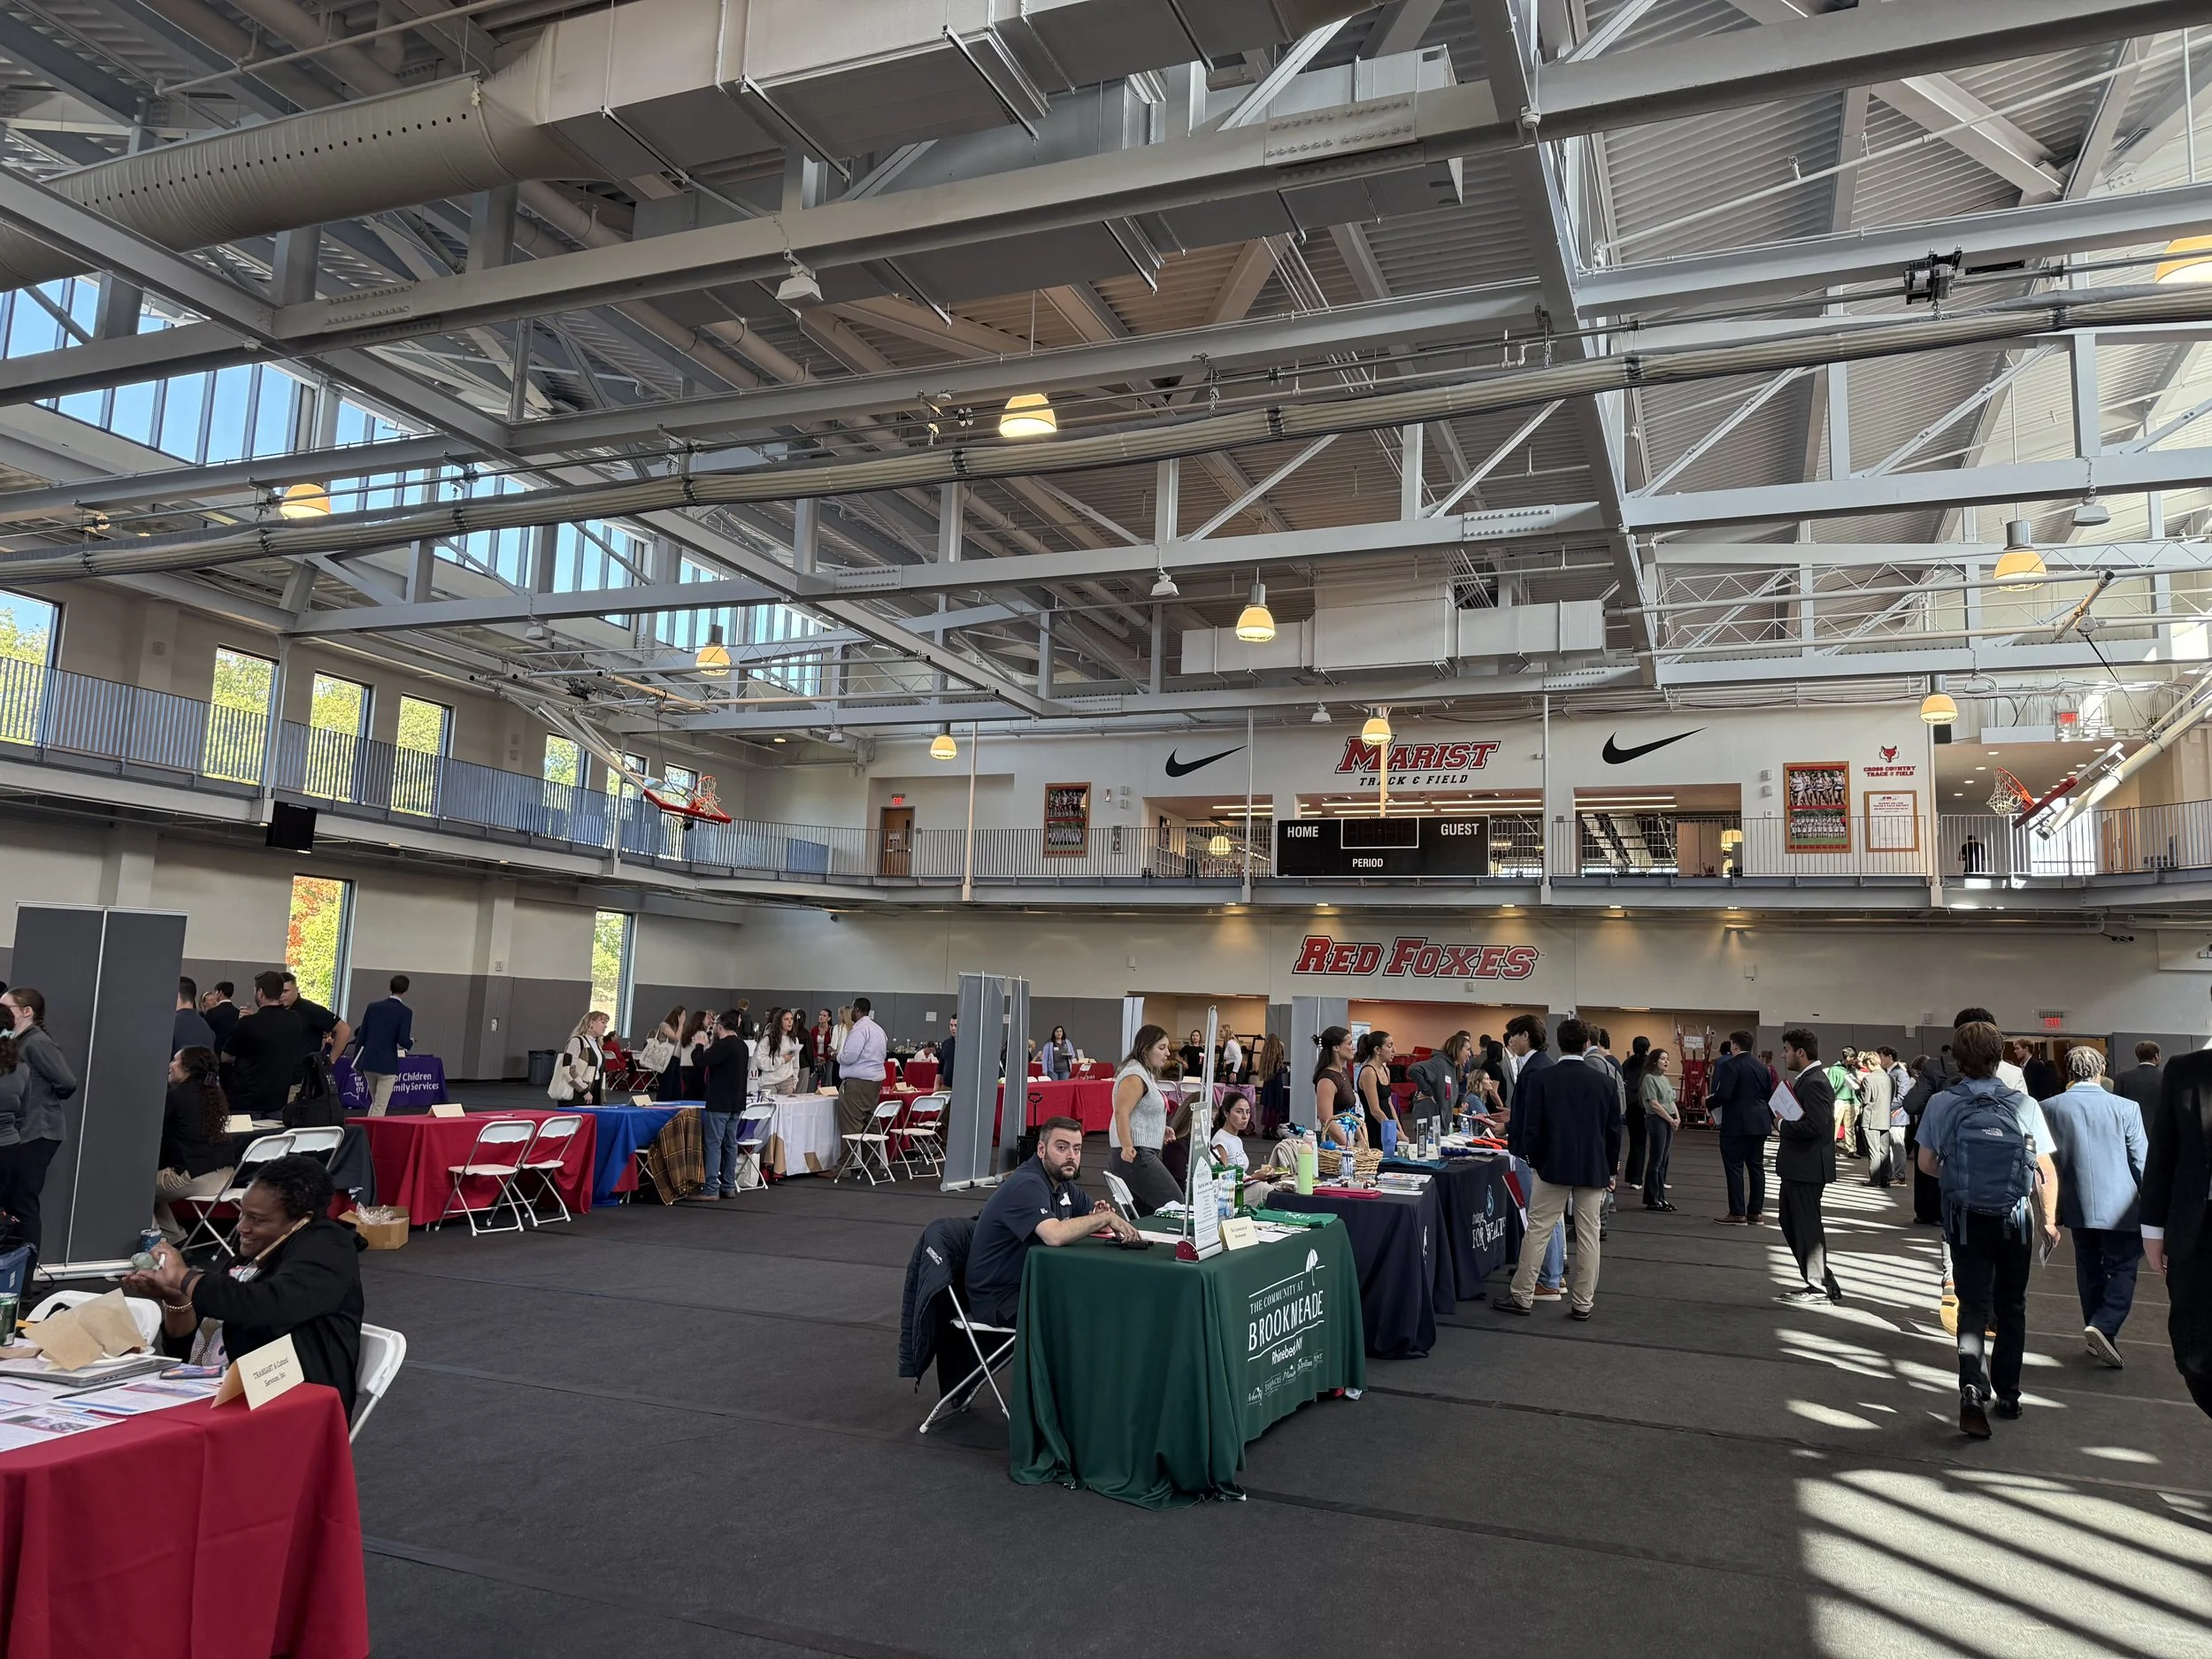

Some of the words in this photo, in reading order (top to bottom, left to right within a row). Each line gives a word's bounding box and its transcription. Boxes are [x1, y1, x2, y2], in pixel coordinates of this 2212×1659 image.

[1334, 734, 1501, 773] MARIST
[1426, 774, 1469, 785] FIELD
[1287, 826, 1319, 838] HOME
[1440, 823, 1479, 836] GUEST
[1352, 858, 1384, 868] PERIOD
[1292, 935, 1385, 976] RED
[1382, 936, 1540, 980] FOXES
[395, 1072, 401, 1082] of
[403, 1071, 432, 1081] Children
[394, 1083, 411, 1094] mily
[411, 1081, 439, 1091] Services
[1249, 1299, 1263, 1315] THE
[1263, 1283, 1296, 1308] COMMUNITY
[1296, 1279, 1303, 1292] AT
